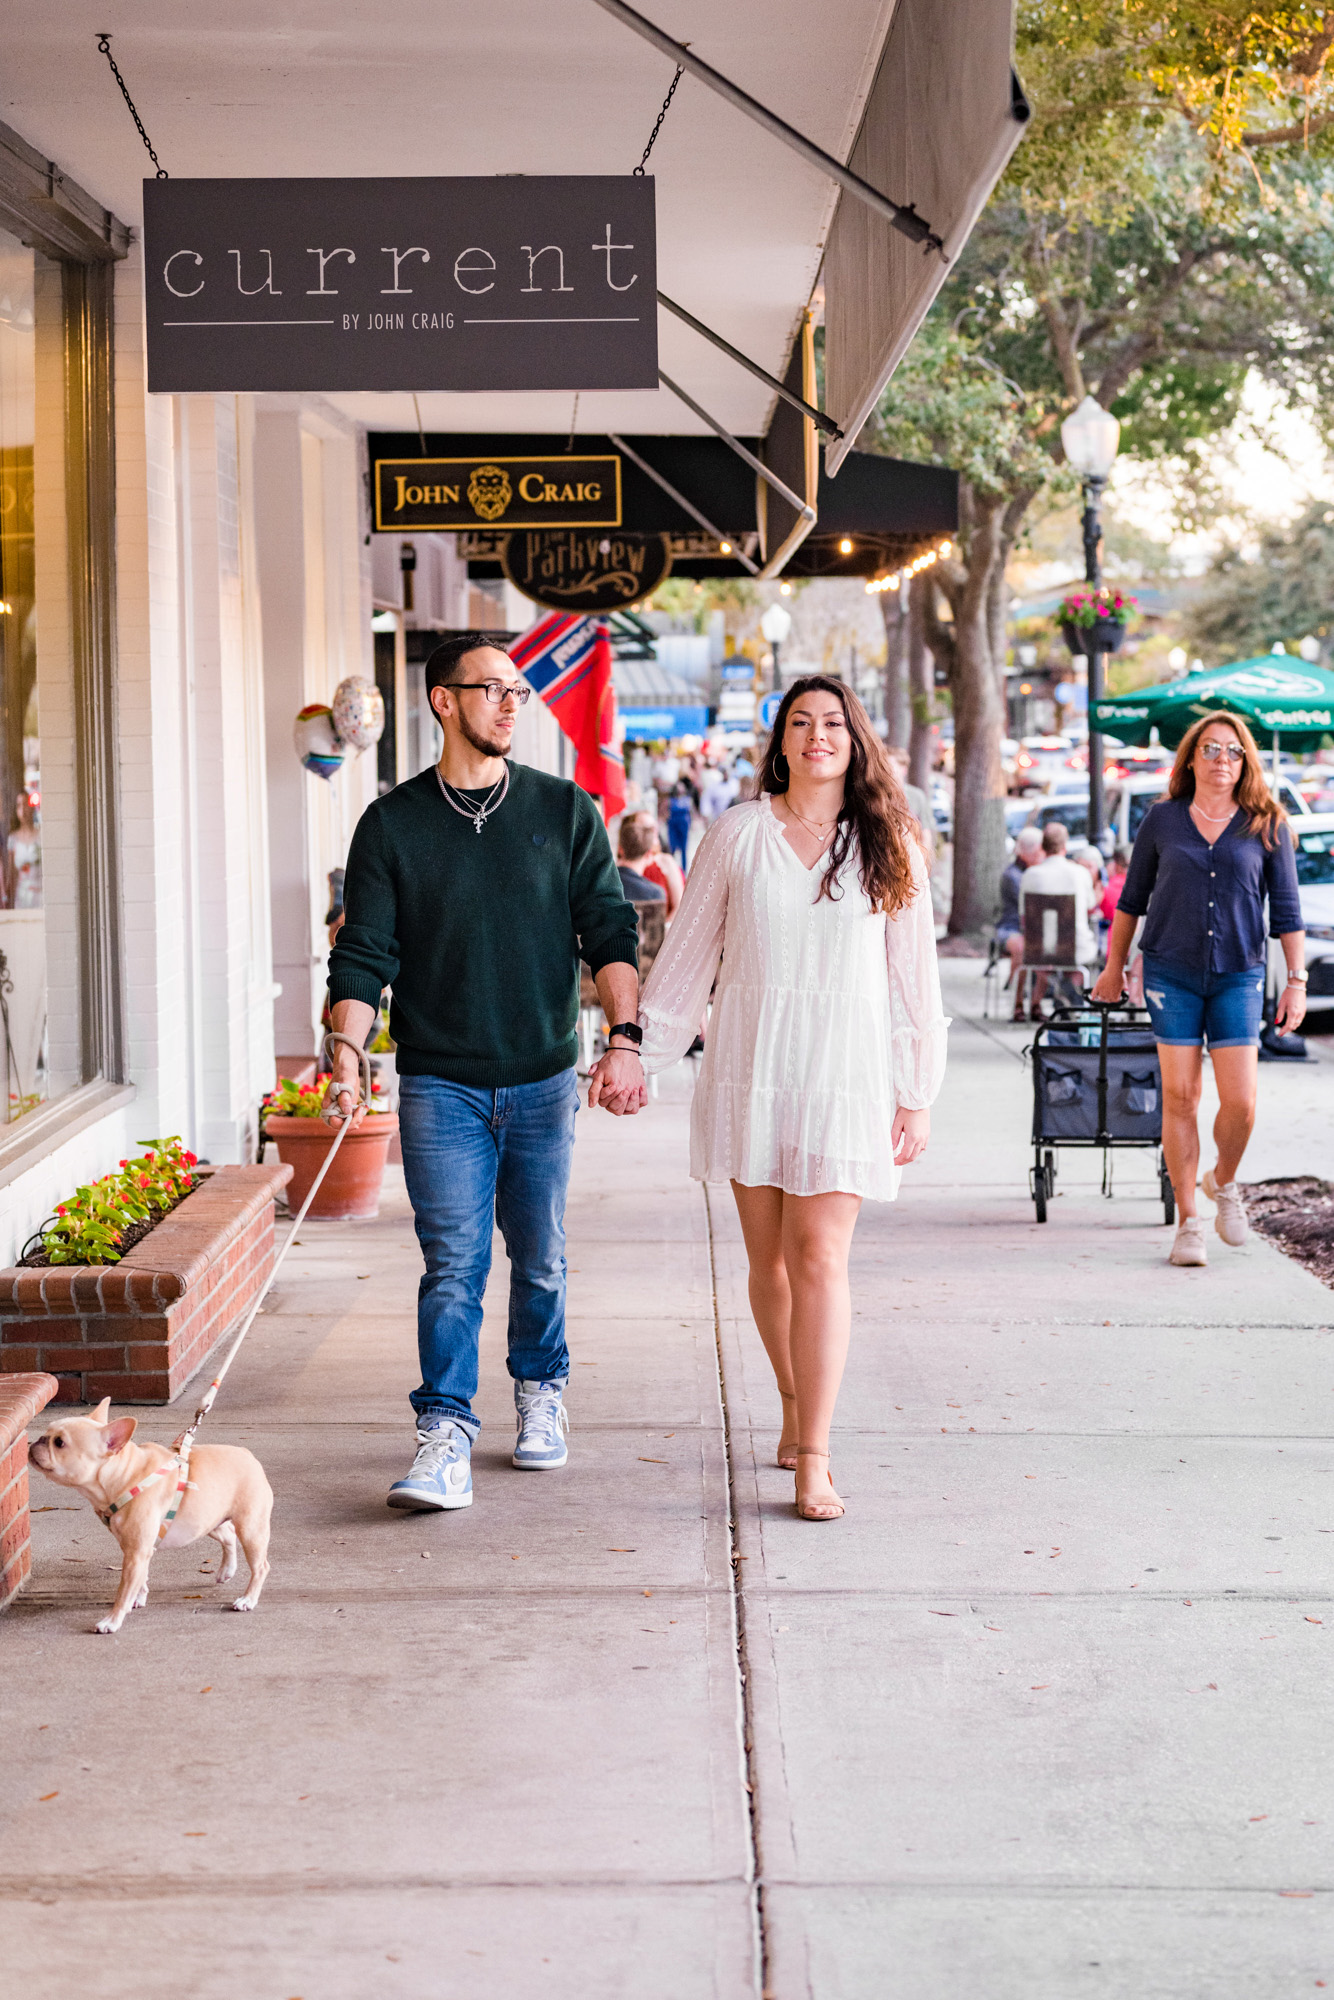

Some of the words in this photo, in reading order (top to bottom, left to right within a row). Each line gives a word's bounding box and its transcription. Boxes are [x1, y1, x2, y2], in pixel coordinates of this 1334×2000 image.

[162, 222, 639, 298] current
[342, 313, 360, 330] BY
[367, 313, 404, 330] JOHN
[412, 312, 454, 330] CRAIG
